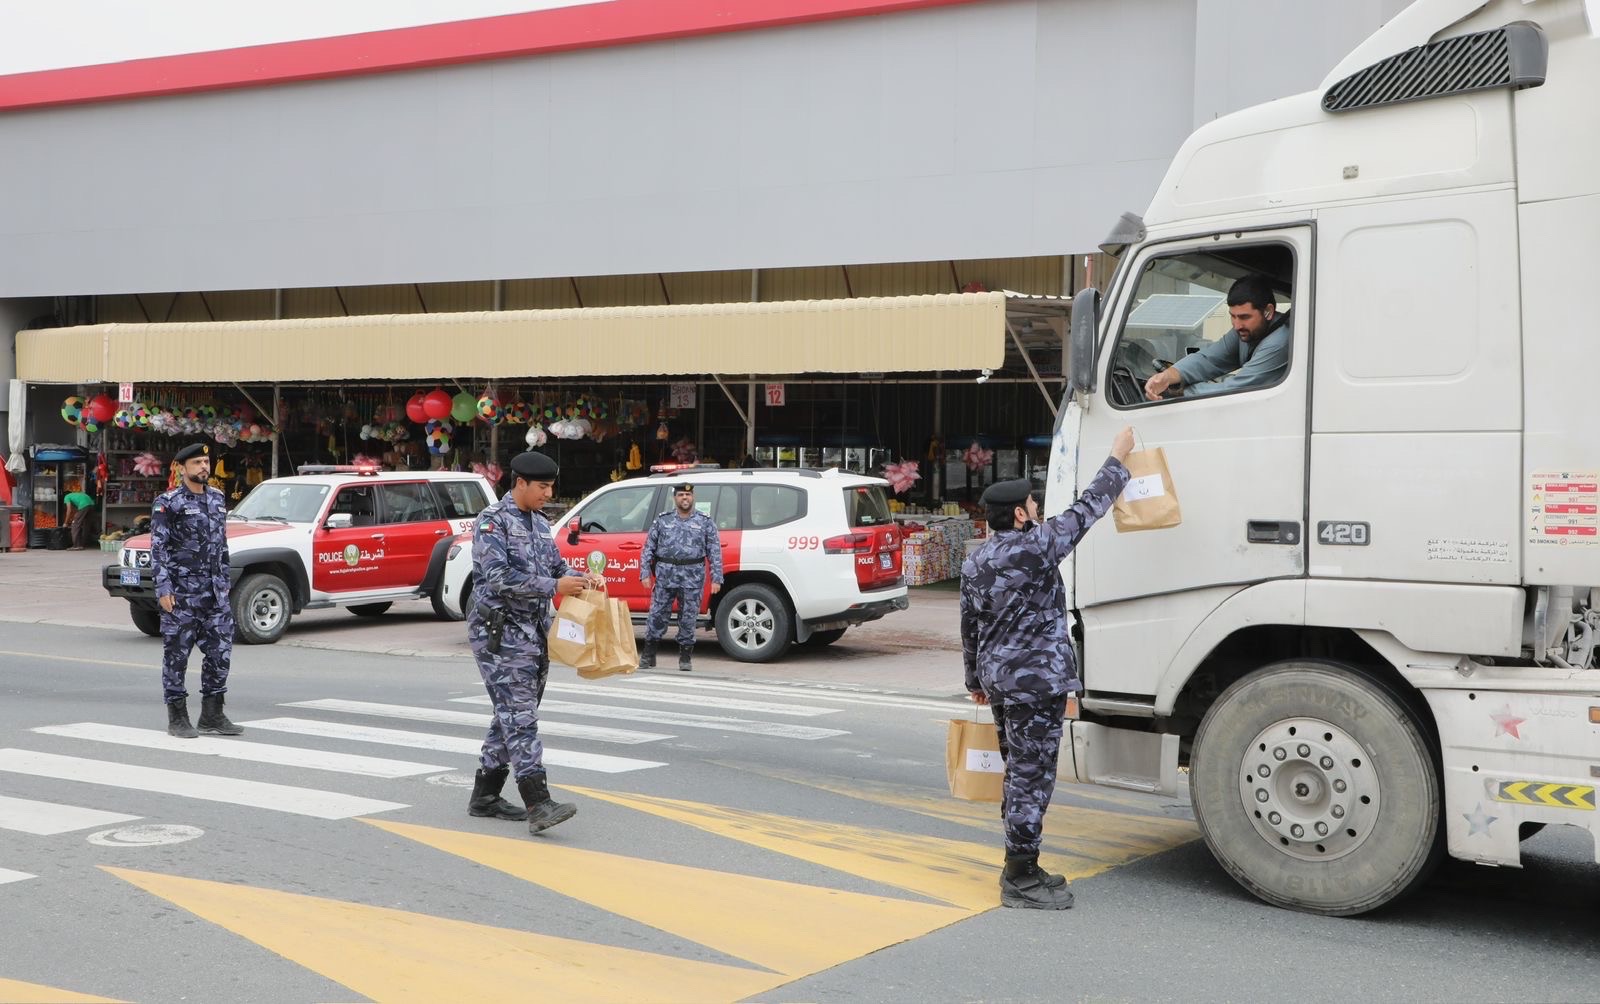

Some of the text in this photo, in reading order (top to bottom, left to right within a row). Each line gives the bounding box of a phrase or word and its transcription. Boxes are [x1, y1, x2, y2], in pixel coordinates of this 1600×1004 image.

[121, 388, 131, 400] 14
[768, 390, 782, 404] 12
[677, 395, 689, 407] 13
[459, 520, 474, 532] 99
[1321, 524, 1366, 542] 420
[788, 536, 819, 550] 999
[319, 552, 343, 563] POLICE
[360, 549, 384, 561] الشرطة
[858, 557, 874, 565] POLICE
[607, 558, 639, 571] الشرطة
